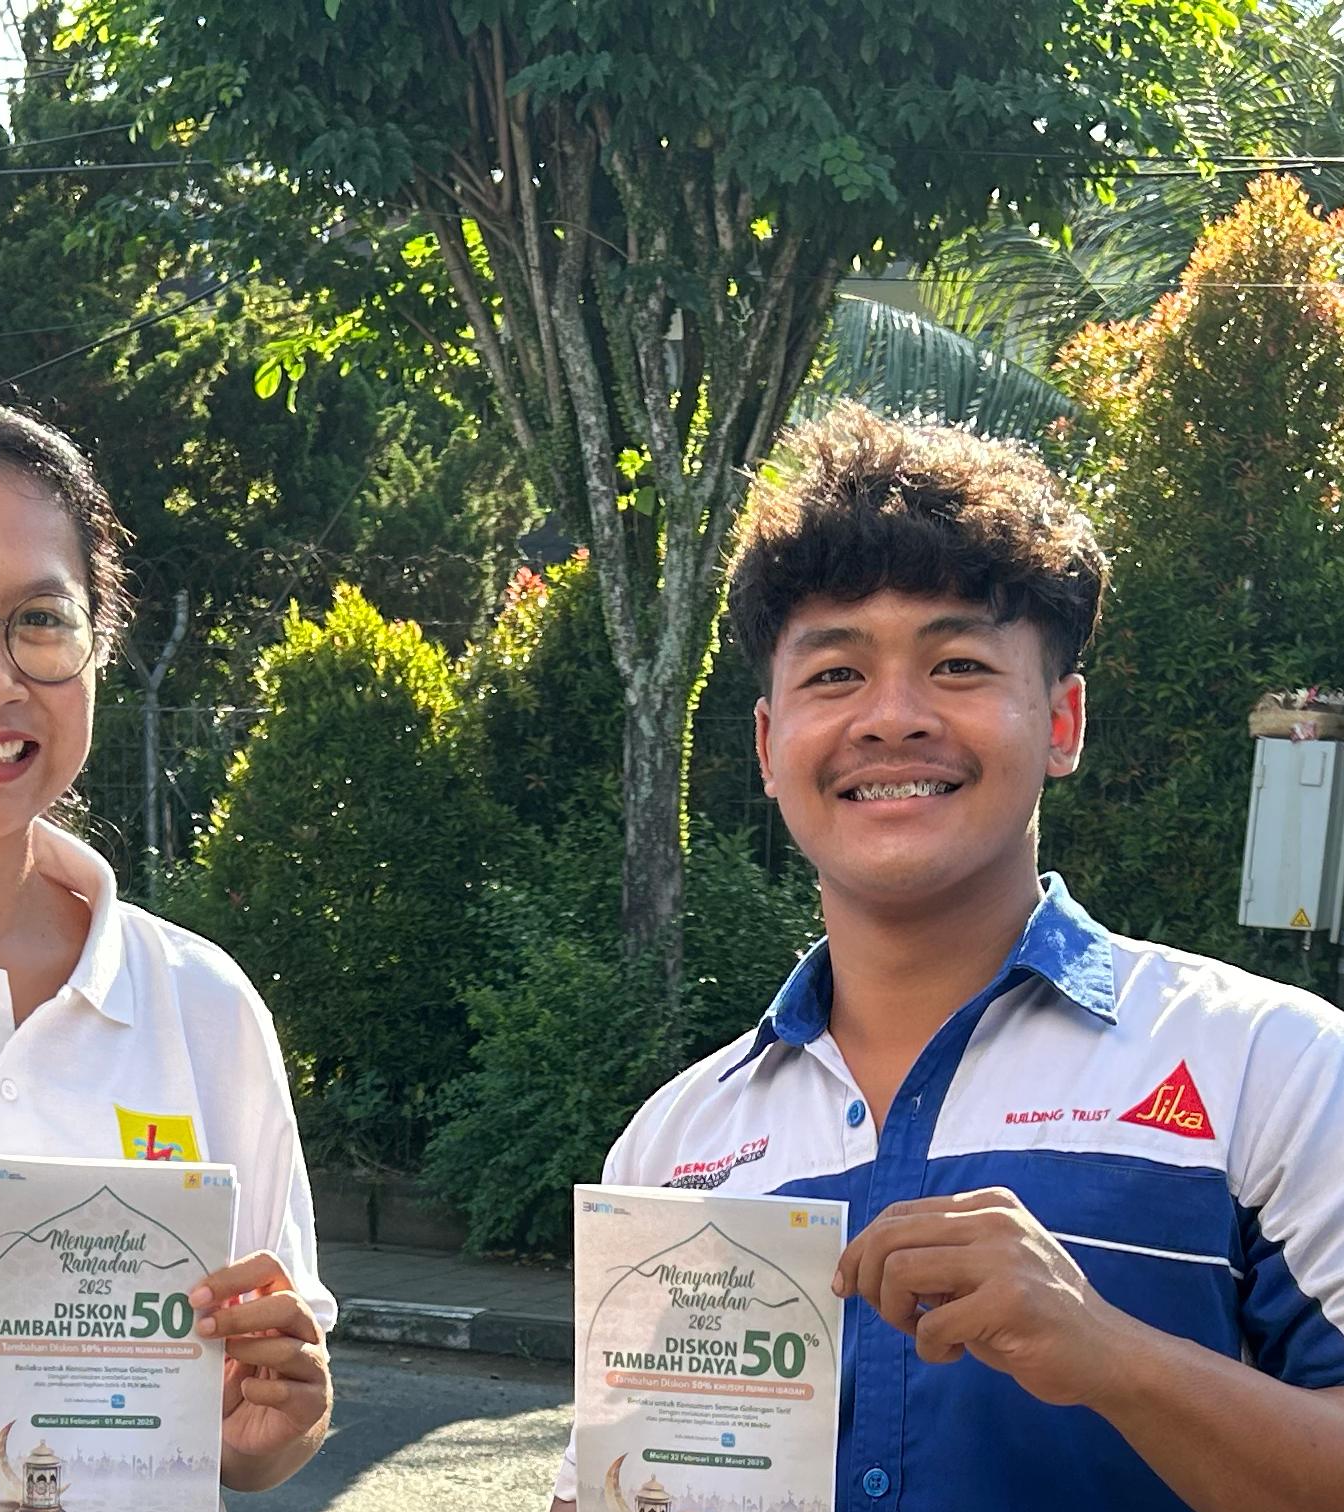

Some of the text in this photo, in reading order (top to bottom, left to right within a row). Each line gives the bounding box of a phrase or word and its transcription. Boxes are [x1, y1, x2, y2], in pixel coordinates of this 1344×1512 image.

[1006, 1108, 1111, 1124] BUILDING TRUST
[1136, 1085, 1204, 1130] Sika
[810, 1216, 840, 1227] PLN
[50, 1229, 147, 1257] Menyambut
[59, 1252, 142, 1274] Ramadan
[78, 1279, 112, 1295] 2025
[658, 1264, 755, 1292] Menyambut
[668, 1287, 751, 1311] Ramadan
[54, 1303, 127, 1320] DISKON
[78, 1321, 126, 1338] DAYA
[689, 1315, 722, 1331] 2025
[665, 1337, 737, 1357] DISKON
[741, 1330, 820, 1379] 50%
[603, 1351, 738, 1376] TAMBAH DAYA
